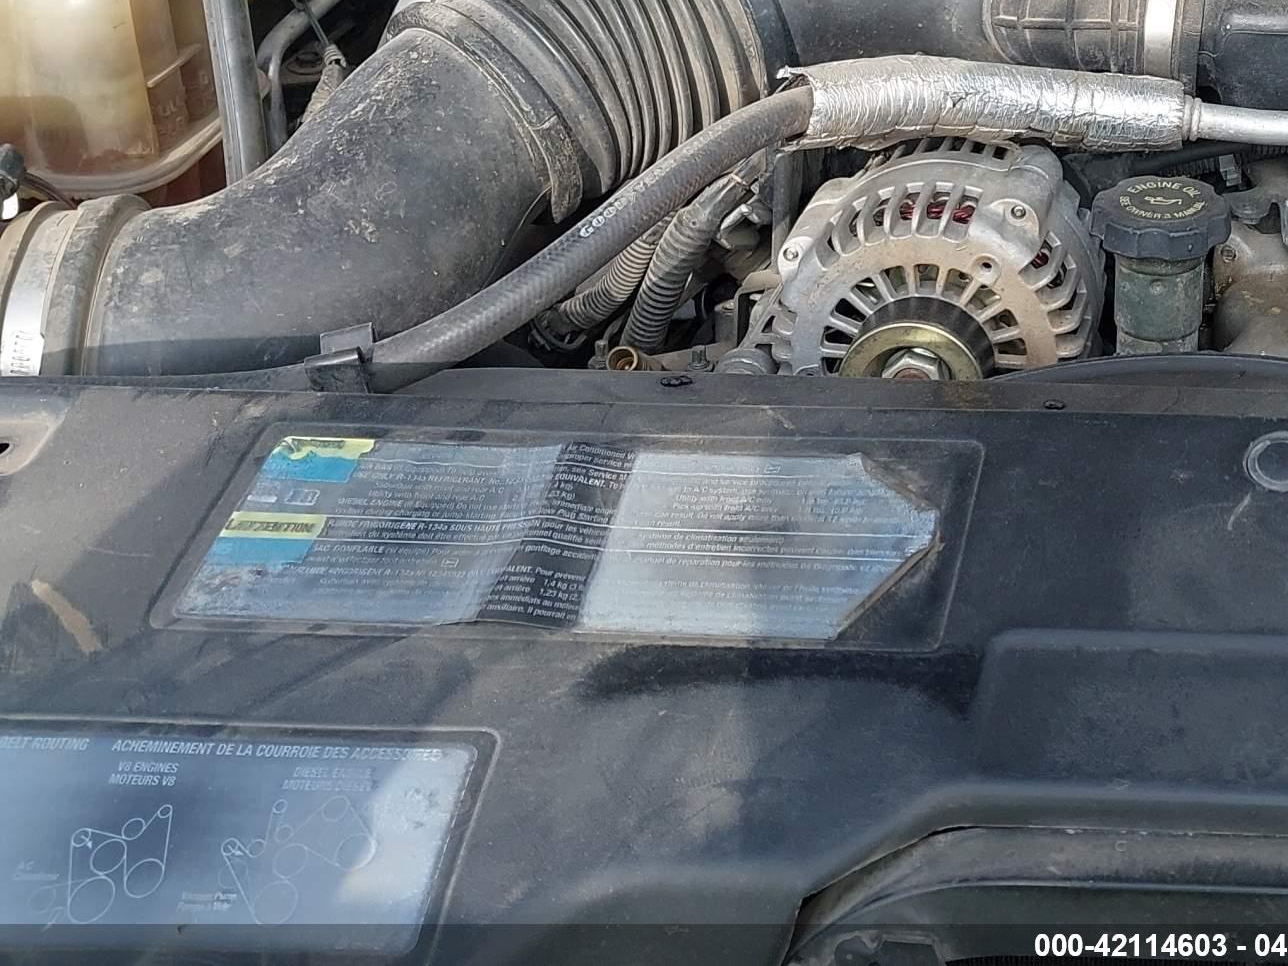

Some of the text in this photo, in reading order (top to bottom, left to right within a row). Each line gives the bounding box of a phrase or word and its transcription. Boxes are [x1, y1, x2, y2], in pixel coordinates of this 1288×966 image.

[1127, 181, 1201, 198] ENGINE OIL
[554, 473, 606, 488] EQUIVALENT.
[588, 468, 617, 480] Service
[418, 522, 448, 532] R-134a
[449, 523, 473, 532] SOUS
[474, 522, 500, 532] HAUTE
[524, 544, 562, 556] gonflage
[31, 737, 91, 751] ROUTING
[111, 738, 217, 755] ACHEMINEMENT
[216, 743, 234, 756] DE
[236, 744, 253, 757] LA
[256, 744, 325, 759] COURROIE
[323, 746, 350, 760] DES
[118, 761, 180, 774] V8 ENGINES
[108, 773, 177, 787] MOTEURS V8
